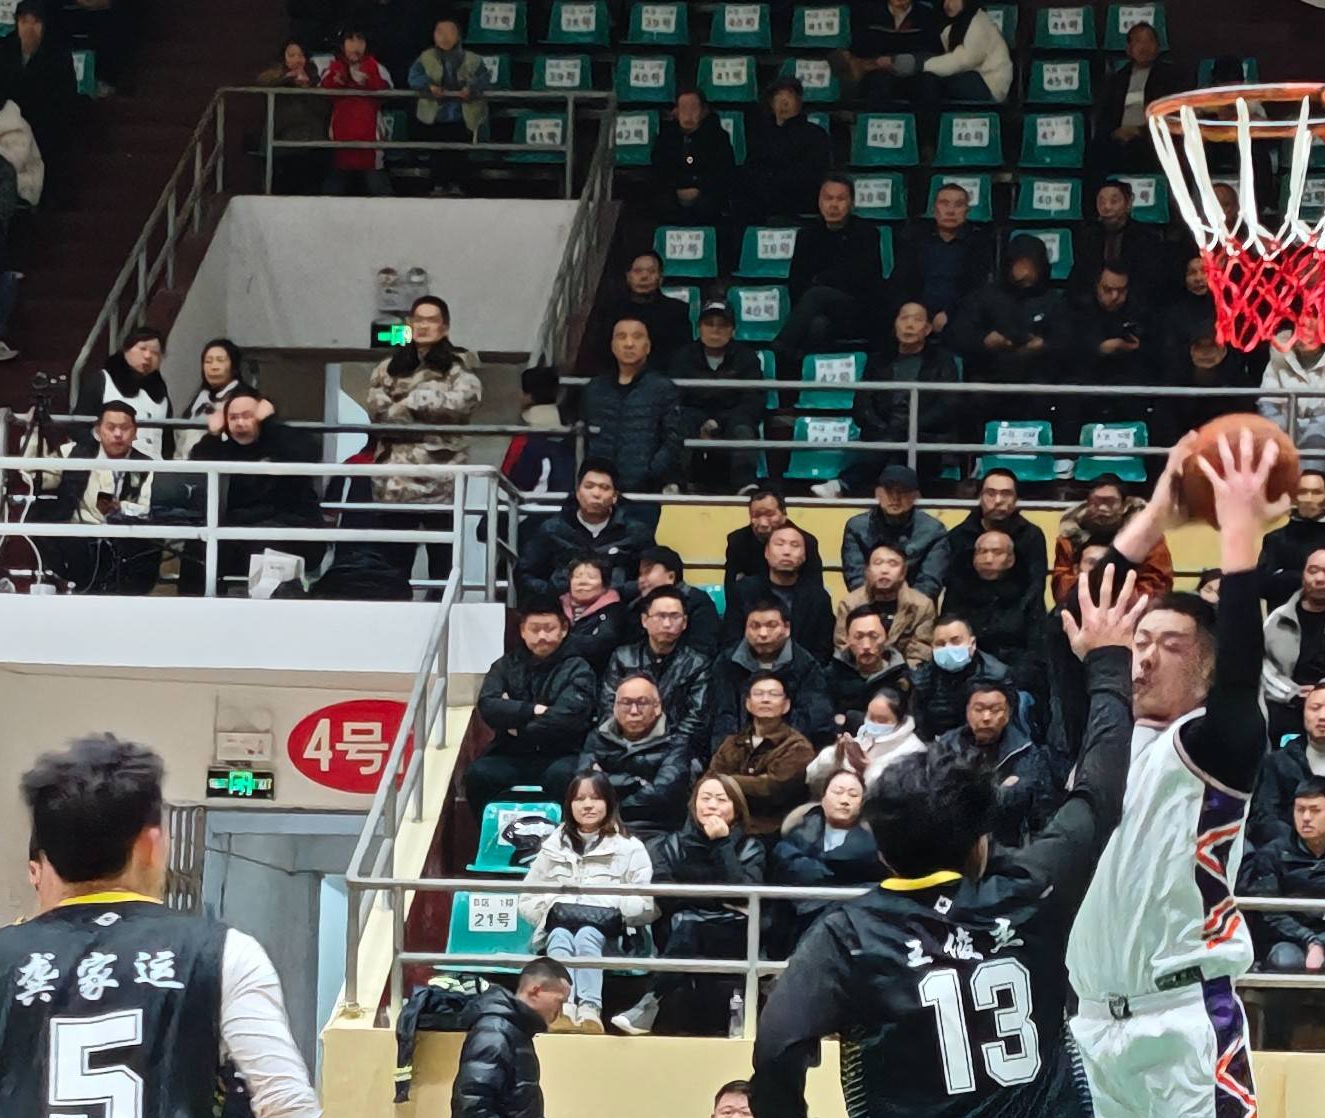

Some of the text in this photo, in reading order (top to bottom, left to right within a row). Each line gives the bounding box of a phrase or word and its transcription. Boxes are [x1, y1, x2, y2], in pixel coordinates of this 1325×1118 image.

[303, 718, 405, 776] 4号
[474, 912, 511, 928] 21号
[918, 957, 1042, 1095] 13
